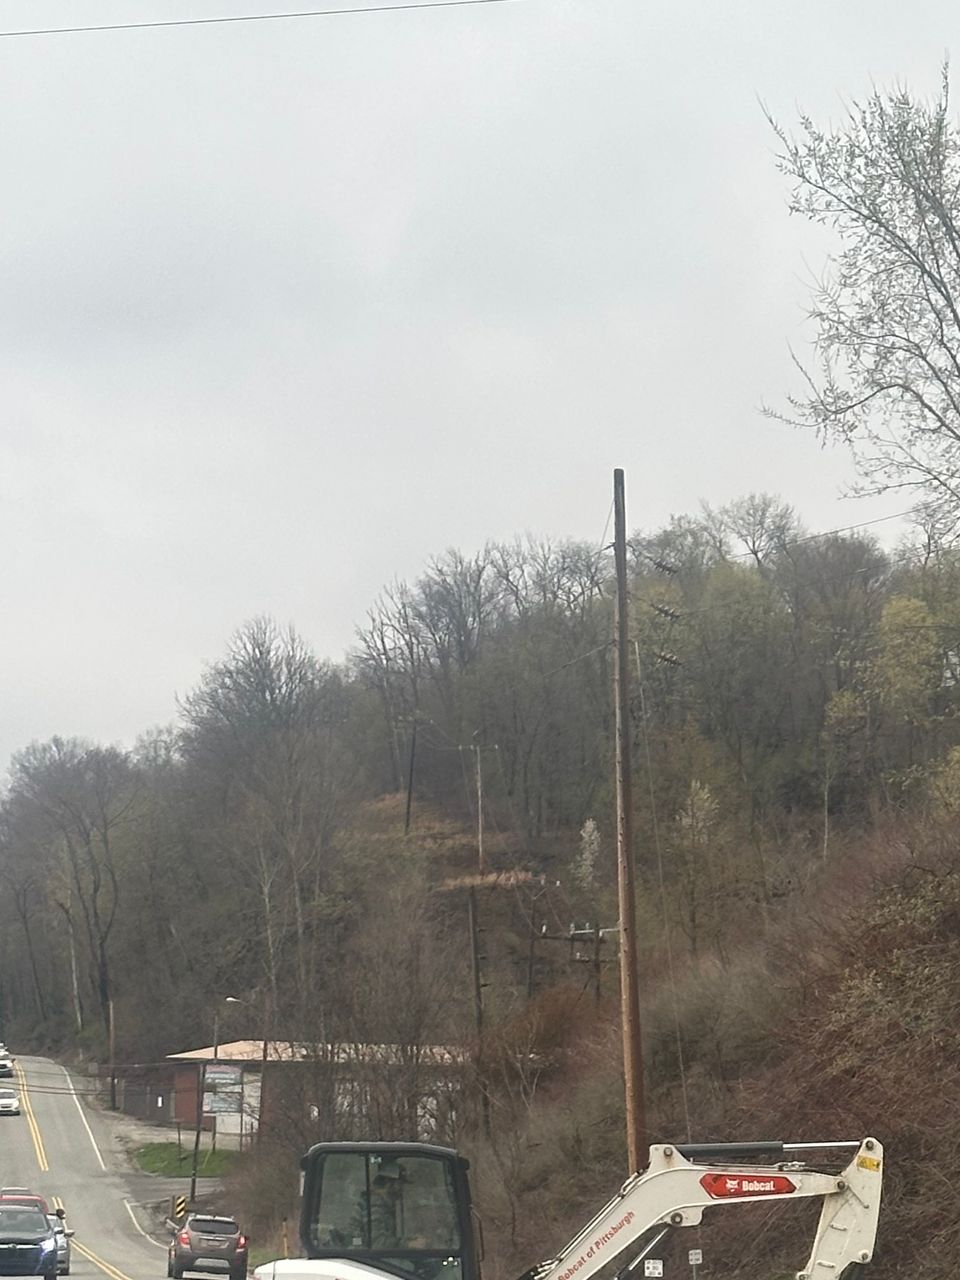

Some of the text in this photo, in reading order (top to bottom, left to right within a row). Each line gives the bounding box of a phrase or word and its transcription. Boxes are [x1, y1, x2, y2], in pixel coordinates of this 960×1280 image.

[741, 1180, 776, 1192] Bobcat
[586, 1246, 596, 1259] of
[594, 1210, 635, 1250] Pittsburgh
